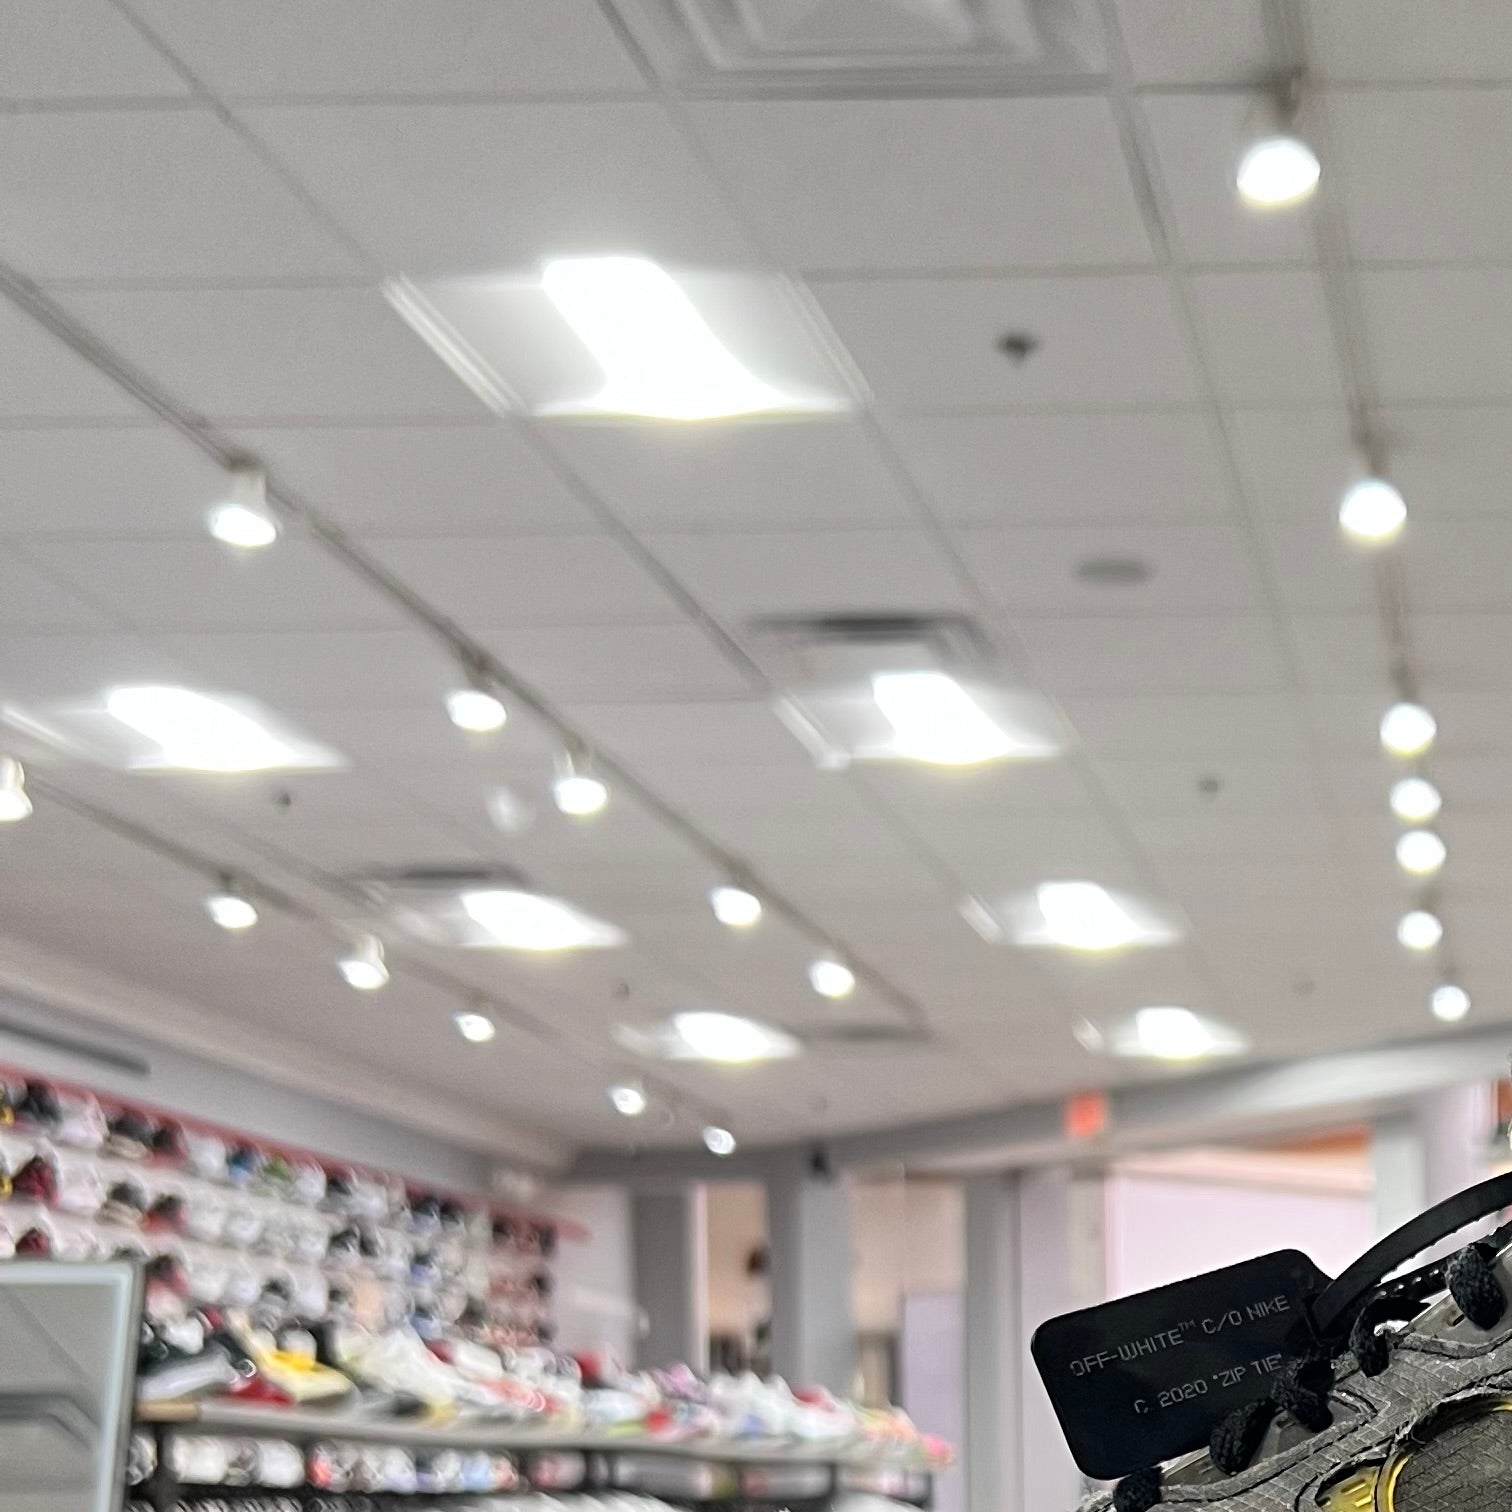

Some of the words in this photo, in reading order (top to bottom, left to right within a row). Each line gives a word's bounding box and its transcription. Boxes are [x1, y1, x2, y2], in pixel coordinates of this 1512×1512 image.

[1201, 1310, 1243, 1335] C/O
[1246, 1295, 1291, 1321] NIKE
[1157, 1379, 1209, 1408] 2020
